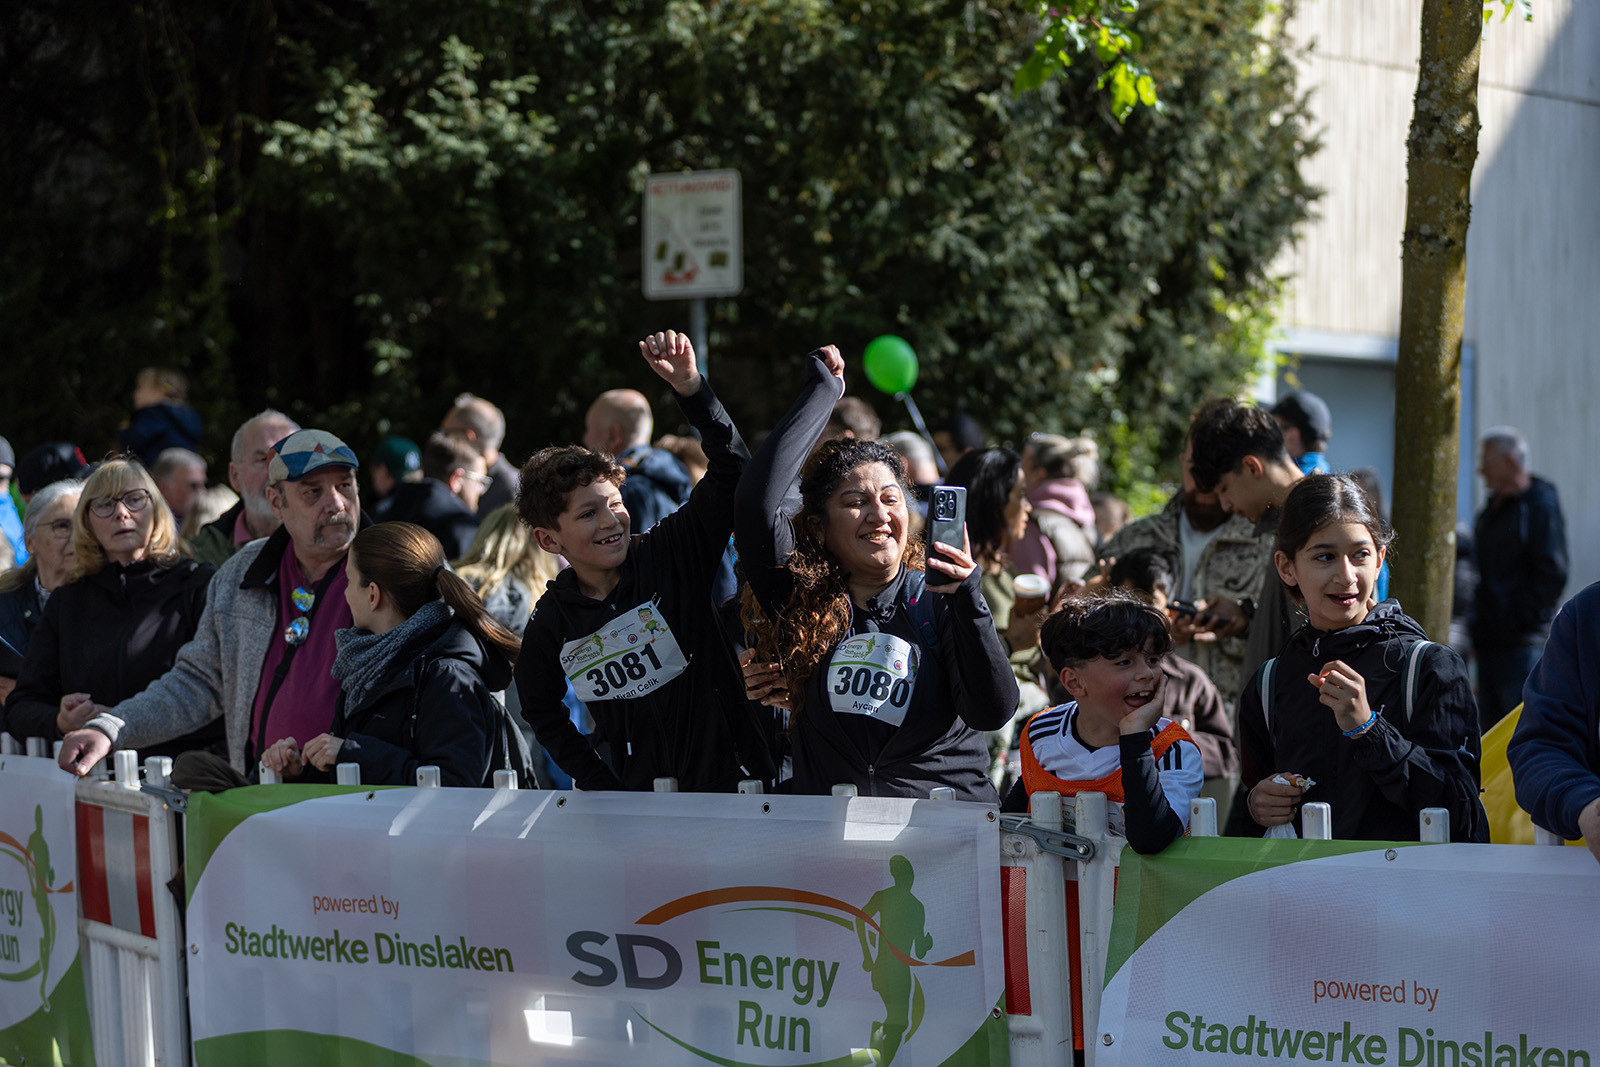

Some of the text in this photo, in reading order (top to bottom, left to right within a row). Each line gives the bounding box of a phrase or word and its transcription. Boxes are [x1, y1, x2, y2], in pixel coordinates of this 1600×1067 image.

[561, 655, 576, 664] SD
[586, 642, 663, 698] 3081
[637, 677, 660, 692] Celik
[834, 666, 910, 708] 3080
[852, 700, 879, 713] Aycan
[312, 894, 400, 920] powered by
[0, 933, 20, 964] un
[225, 921, 515, 973] Stadtwerke Dinslaken
[565, 929, 840, 1008] SD Energy
[1313, 978, 1440, 1012] powered by
[736, 999, 812, 1054] Run
[1162, 1010, 1591, 1067] Stadtwerke Dinslaken
